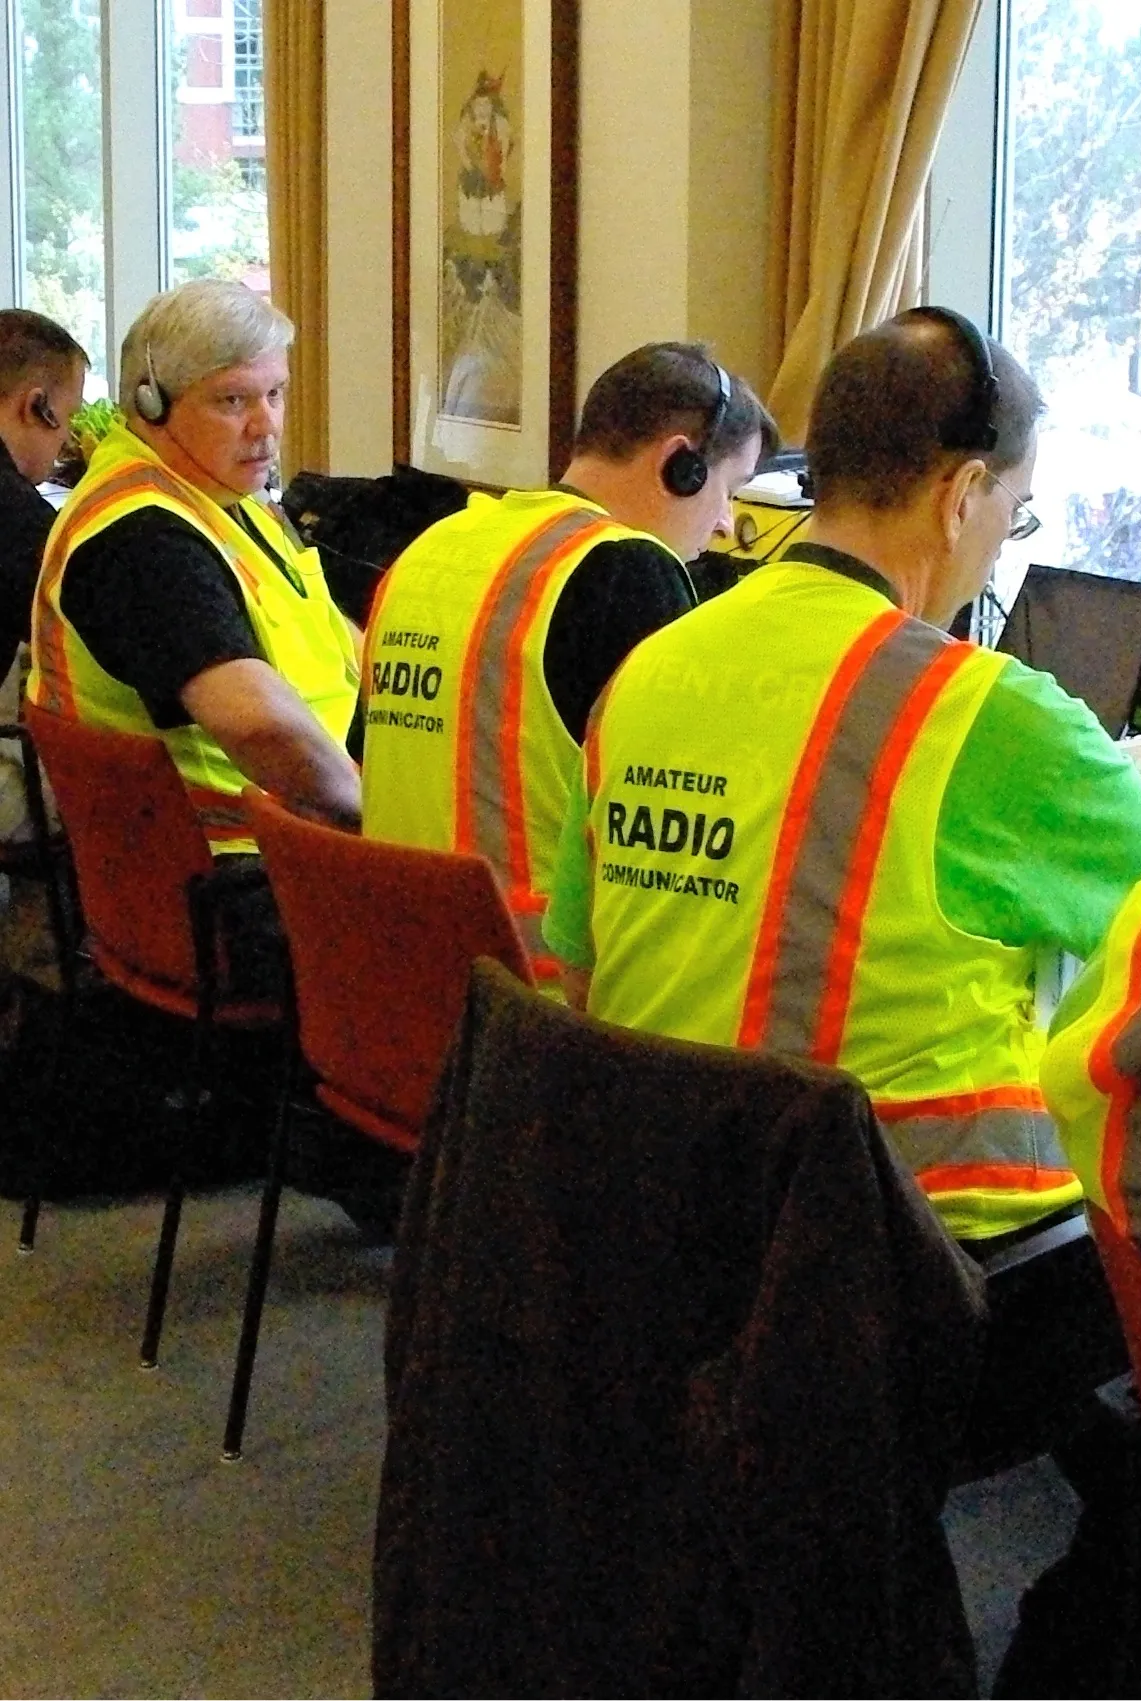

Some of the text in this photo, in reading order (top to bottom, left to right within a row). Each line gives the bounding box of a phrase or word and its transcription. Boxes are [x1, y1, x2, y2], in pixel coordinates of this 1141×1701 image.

[382, 631, 440, 651] AMATEUR
[371, 661, 443, 701] RADIO
[624, 765, 728, 797] AMATEUR
[608, 801, 735, 861] RADIO
[602, 863, 740, 904] COMMUNICATOR
